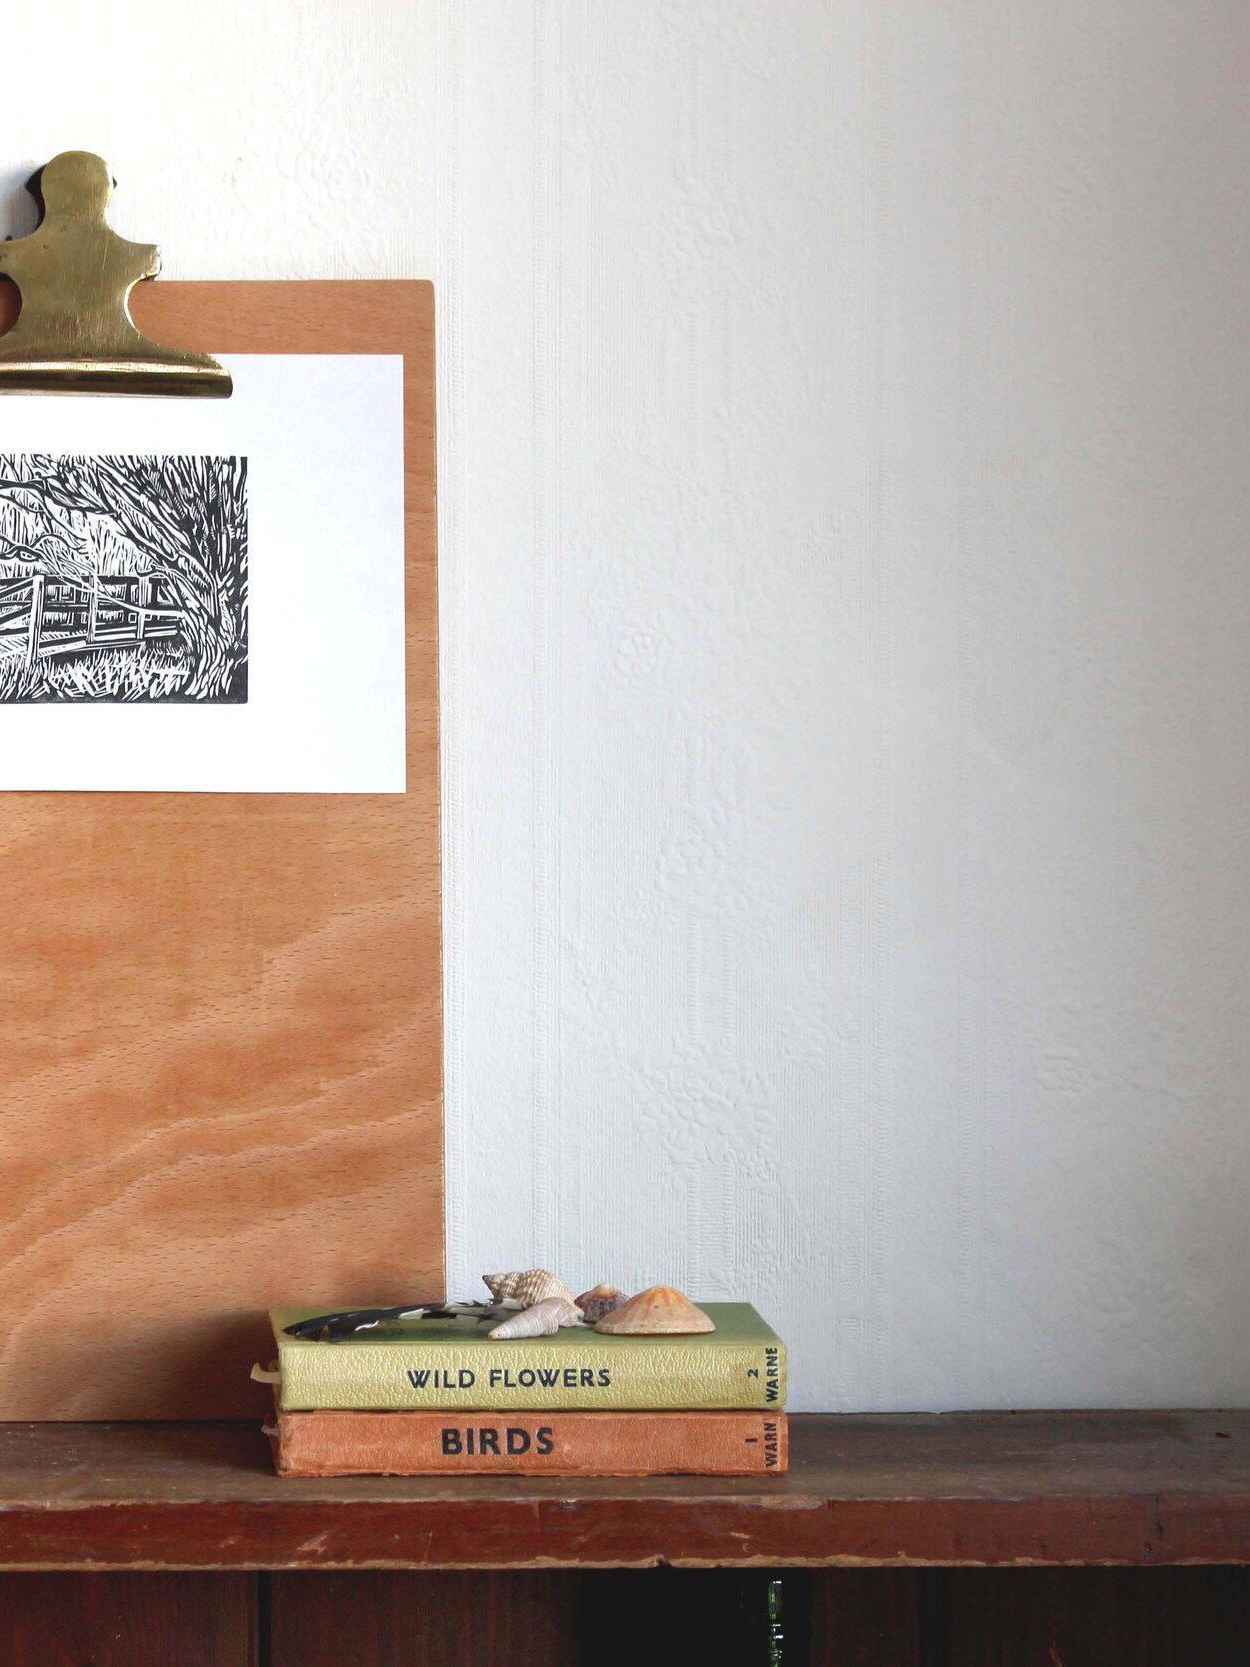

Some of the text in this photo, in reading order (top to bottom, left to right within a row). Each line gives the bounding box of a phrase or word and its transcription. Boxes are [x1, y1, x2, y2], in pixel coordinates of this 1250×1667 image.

[407, 1368, 611, 1389] WILD FLOWERS
[747, 1368, 759, 1380] 2
[765, 1347, 779, 1403] WARNE
[441, 1426, 554, 1456] BIRDS
